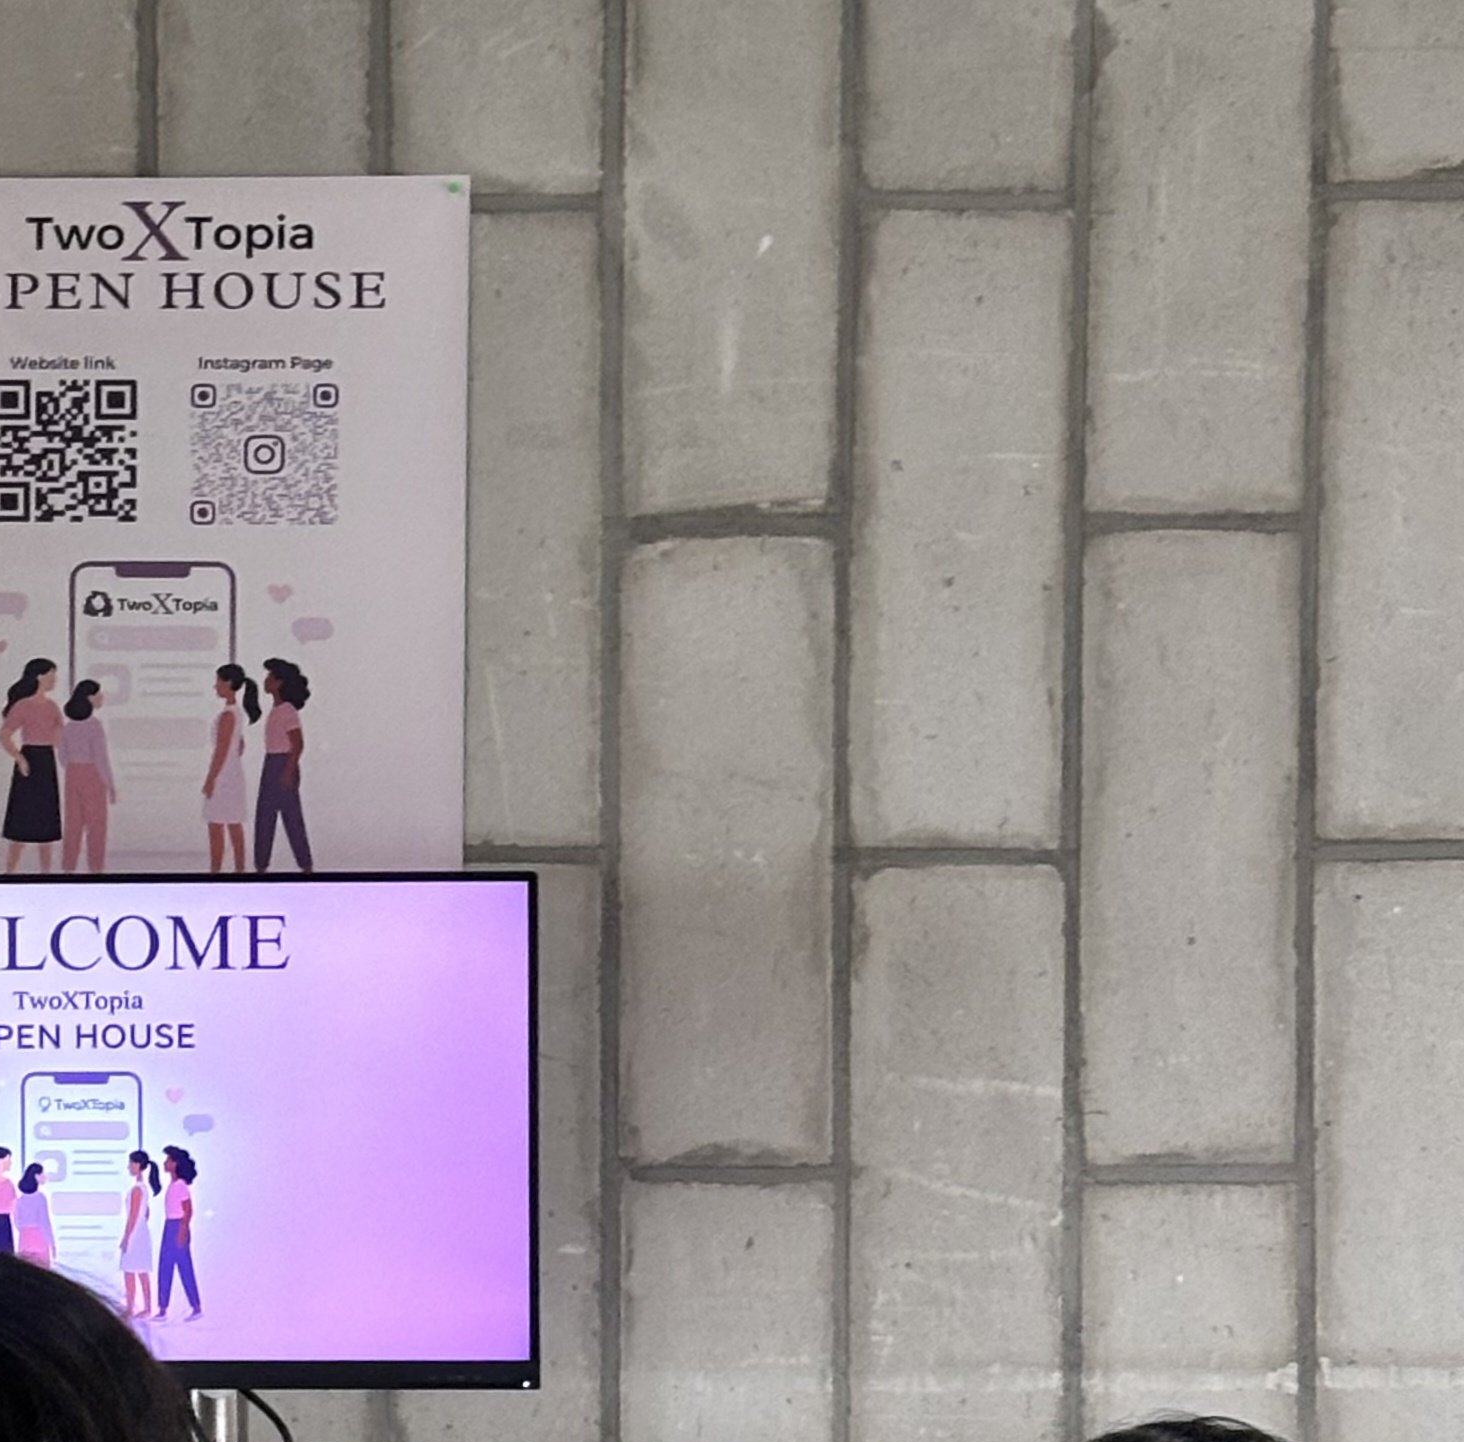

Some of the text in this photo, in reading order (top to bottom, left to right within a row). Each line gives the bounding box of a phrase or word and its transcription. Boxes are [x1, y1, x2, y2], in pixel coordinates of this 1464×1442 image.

[159, 271, 386, 310] HOUSE
[9, 355, 116, 370] Website link
[197, 356, 334, 373] Instagram Page
[12, 990, 144, 1014] TwoXTopia
[75, 1023, 196, 1050] HOUSE
